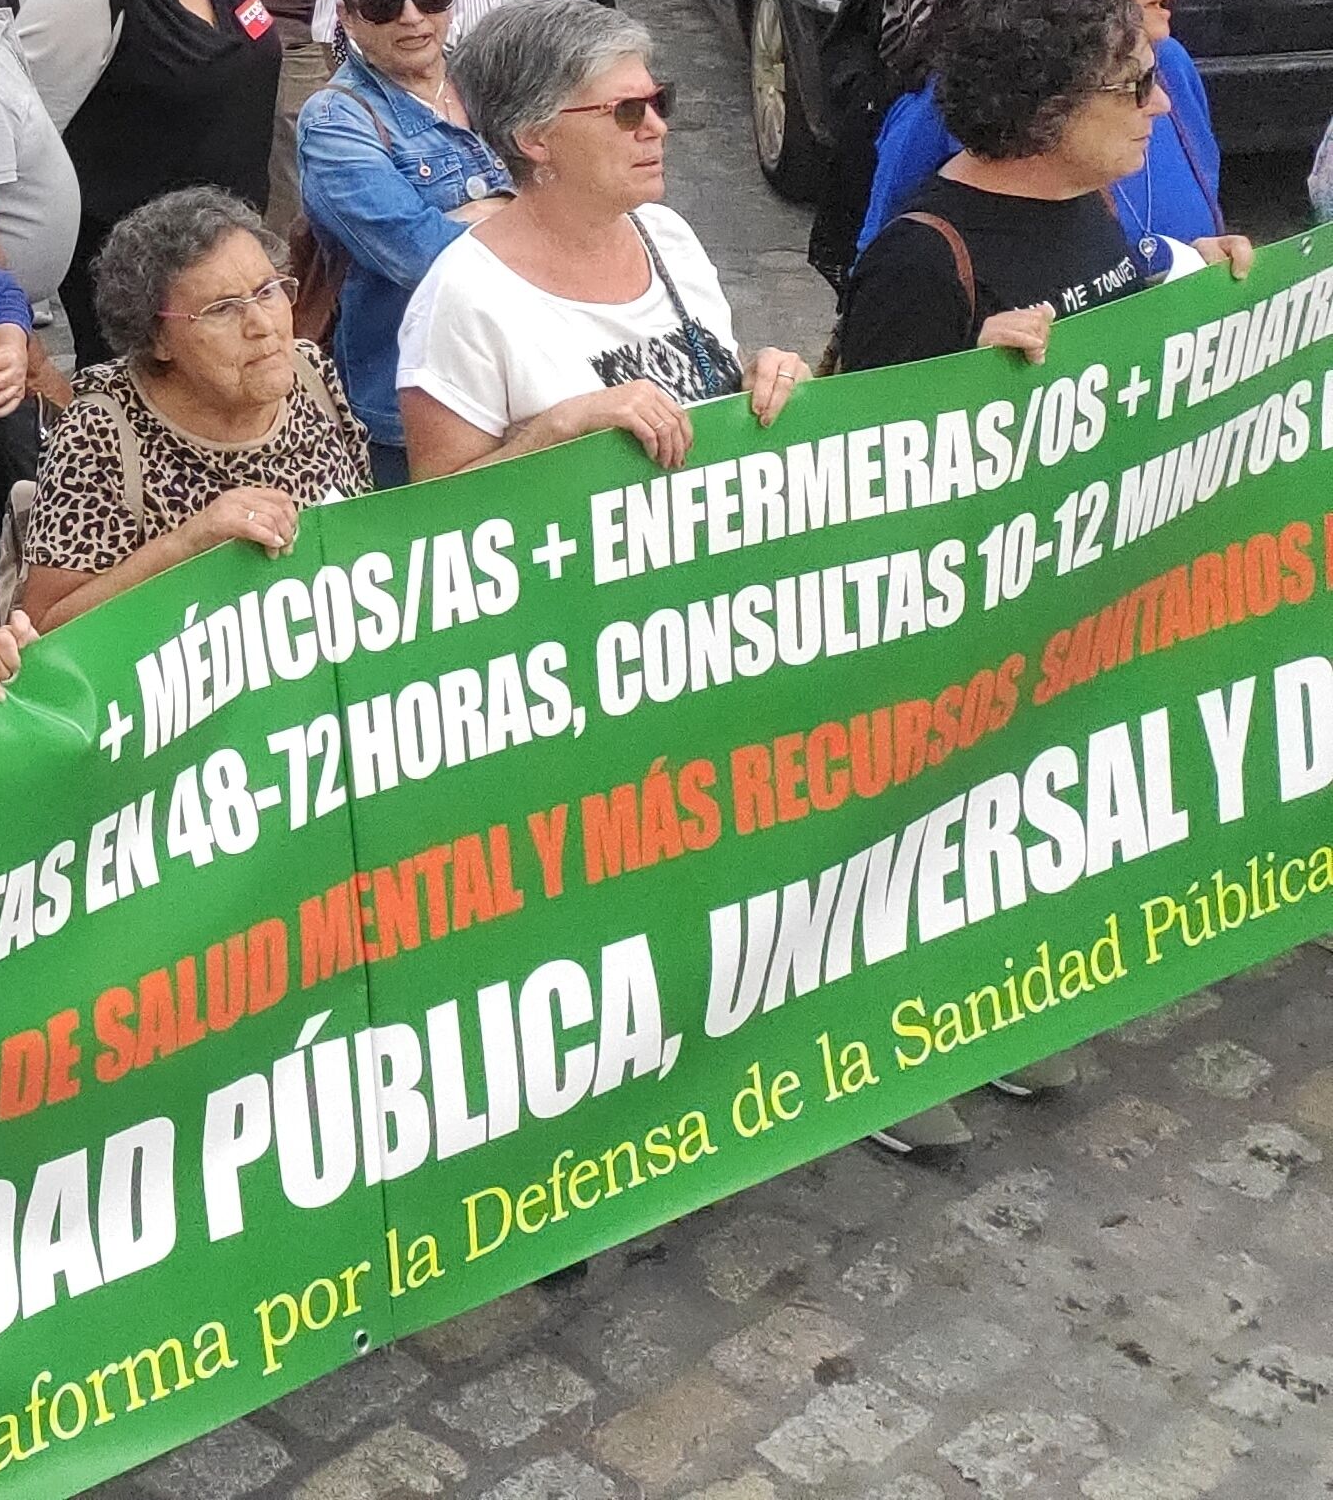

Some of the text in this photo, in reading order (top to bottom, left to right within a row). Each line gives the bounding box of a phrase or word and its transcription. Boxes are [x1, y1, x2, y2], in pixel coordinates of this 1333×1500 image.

[1062, 284, 1087, 312] ME
[1093, 257, 1137, 297] TOQUES
[85, 789, 158, 914] EN
[167, 713, 347, 868] 48-72
[346, 641, 588, 799] HORAS,
[596, 539, 966, 717] CONSULTAS
[977, 480, 1110, 610] 10-12
[1113, 380, 1313, 550] MINUTOS
[94, 918, 289, 1083] SALUD
[299, 823, 525, 988] MENTAL
[527, 803, 570, 898] Y
[584, 754, 723, 885] MÁS
[729, 653, 1026, 836] RECURSOS
[1035, 521, 1316, 706] SANITARIOS
[135, 517, 520, 760] MÉDICOS/AS
[590, 363, 1109, 586] ENFERMERAS/OS
[202, 933, 683, 1242] PÚBLICA,
[704, 706, 1190, 1038] UNIVERSAL
[1196, 676, 1257, 825] Y
[255, 1259, 373, 1376] por
[386, 1228, 445, 1298] la
[462, 1110, 718, 1263] Defensa
[731, 1060, 804, 1138] de
[816, 1032, 880, 1103] la
[890, 913, 1128, 1071] Sanidad
[1139, 846, 1333, 965] Pública
